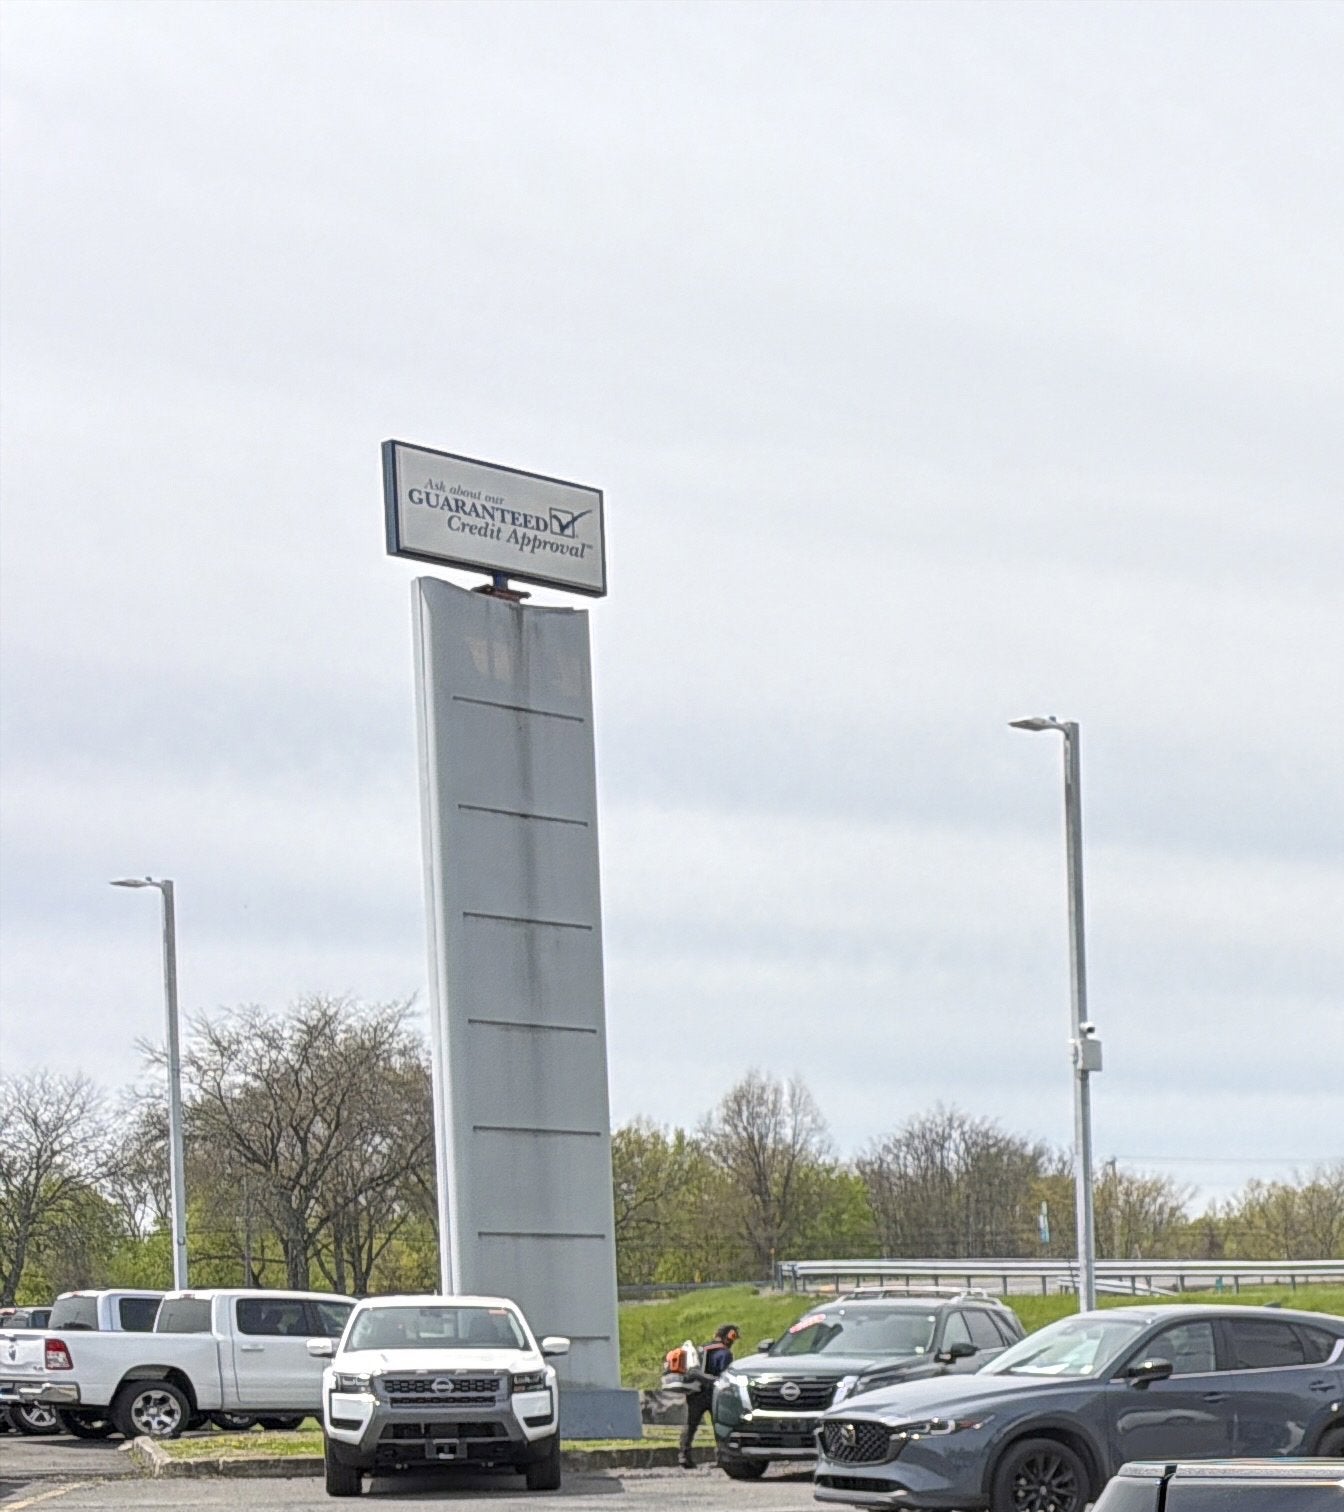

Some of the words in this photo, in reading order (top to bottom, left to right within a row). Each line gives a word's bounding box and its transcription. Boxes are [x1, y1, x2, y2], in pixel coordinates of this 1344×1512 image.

[424, 478, 446, 492] Ask
[449, 484, 481, 500] about
[484, 494, 505, 504] our
[408, 488, 549, 532] GUARANTEED
[448, 515, 502, 542] Credit
